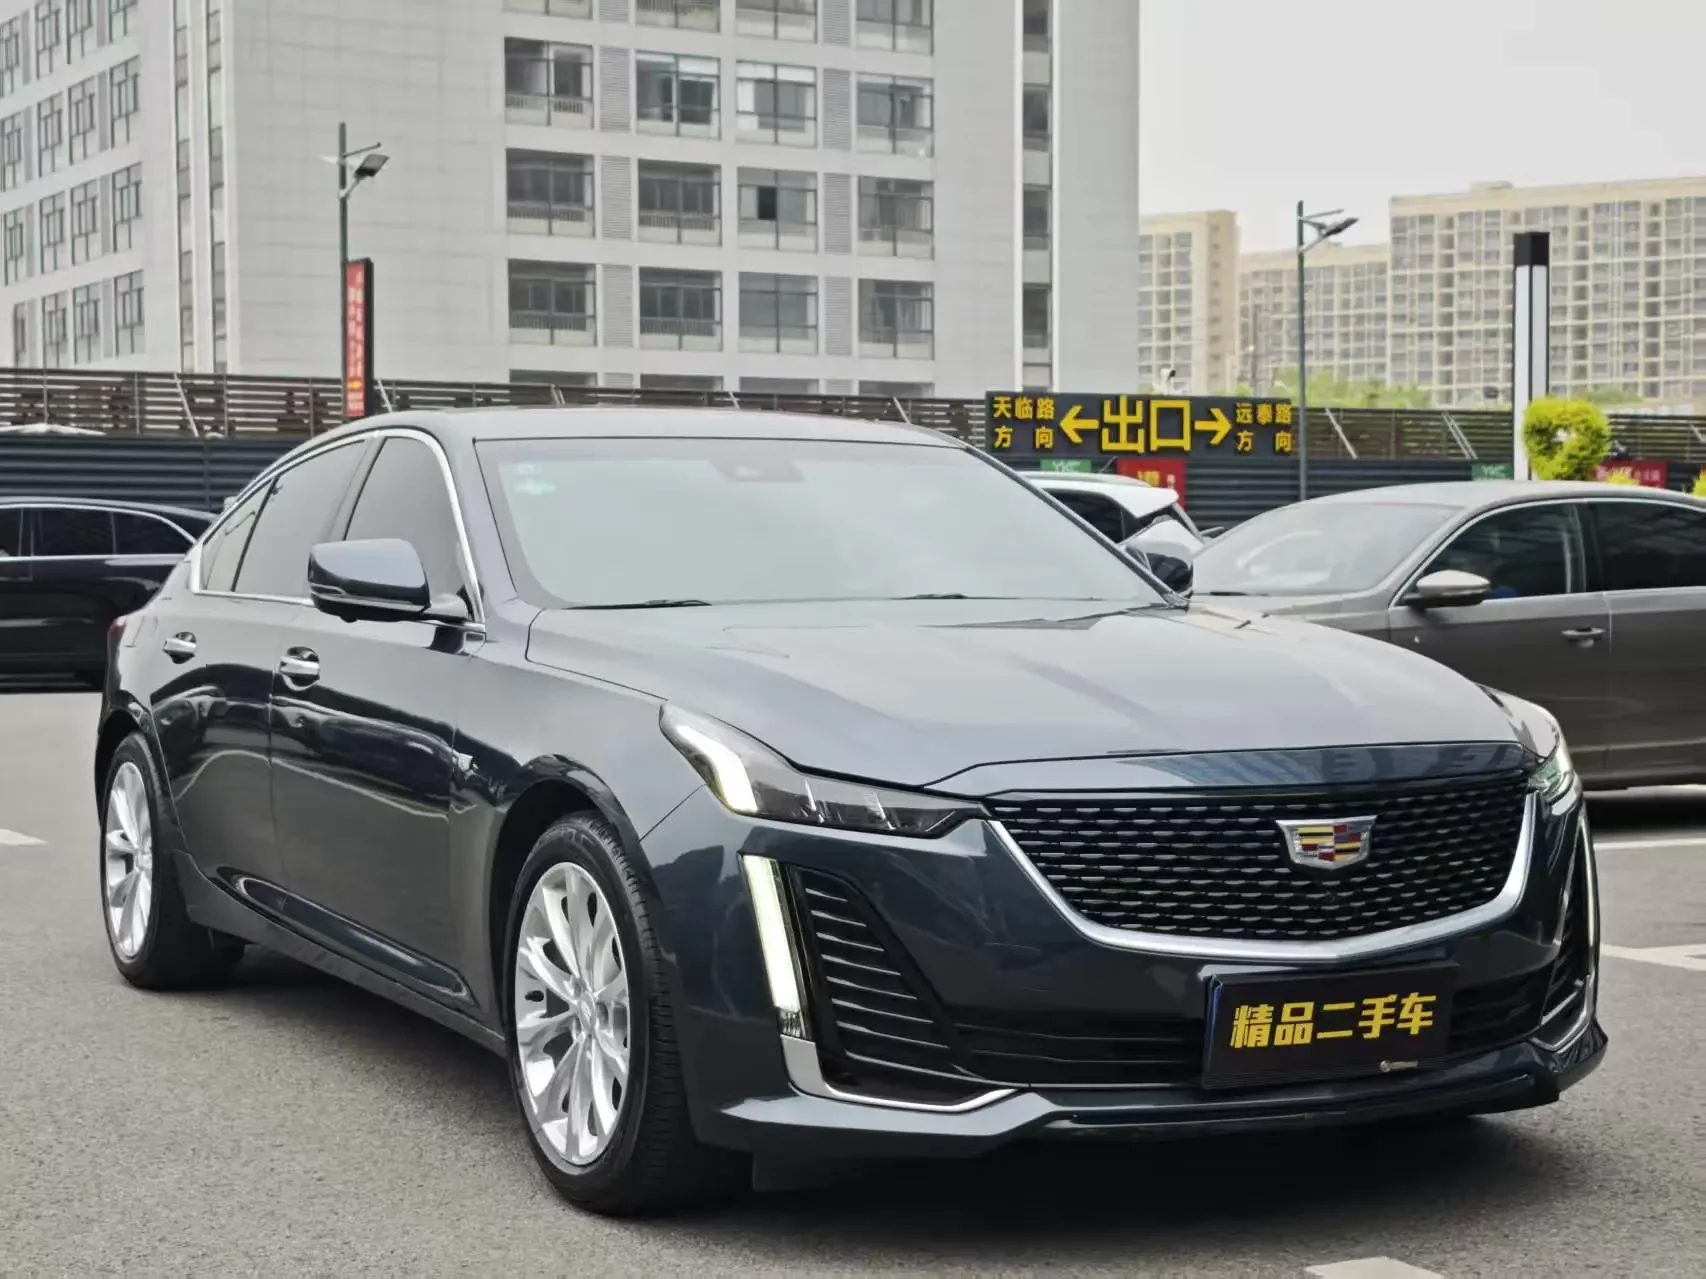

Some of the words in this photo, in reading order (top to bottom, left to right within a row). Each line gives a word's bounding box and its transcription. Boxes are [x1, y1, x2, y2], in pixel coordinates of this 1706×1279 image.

[993, 396, 1054, 419] 天临路
[1101, 395, 1191, 453] 出口
[994, 426, 1053, 449] 方向
[1236, 430, 1292, 452] 方向
[1230, 992, 1437, 1048] 精品二手车
